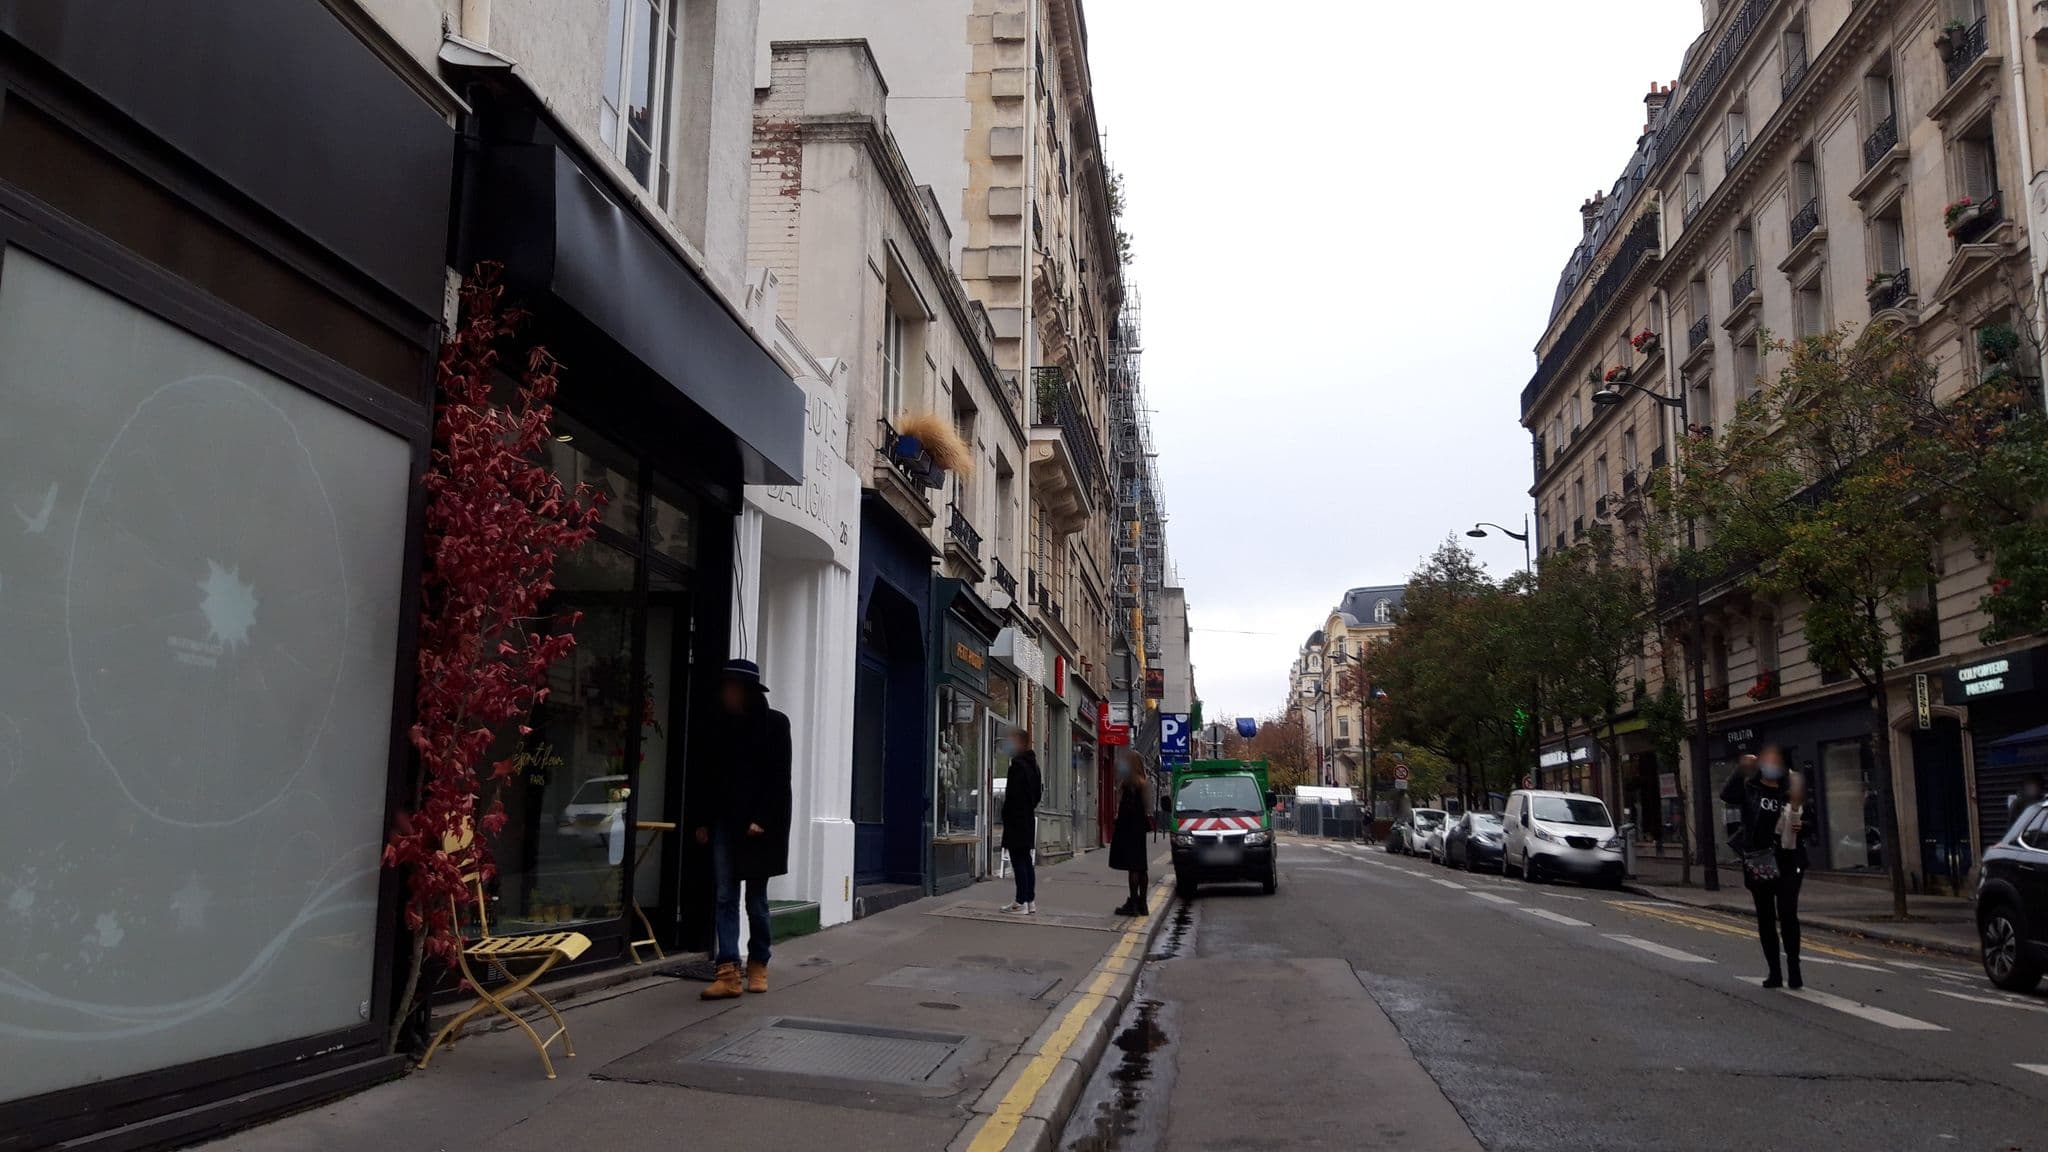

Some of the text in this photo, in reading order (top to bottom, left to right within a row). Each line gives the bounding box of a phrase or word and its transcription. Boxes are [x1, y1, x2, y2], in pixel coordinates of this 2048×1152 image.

[839, 521, 848, 546] 26
[1965, 677, 2004, 697] PRESSING
[1918, 675, 1929, 727] PRESSING
[1161, 719, 1179, 743] P
